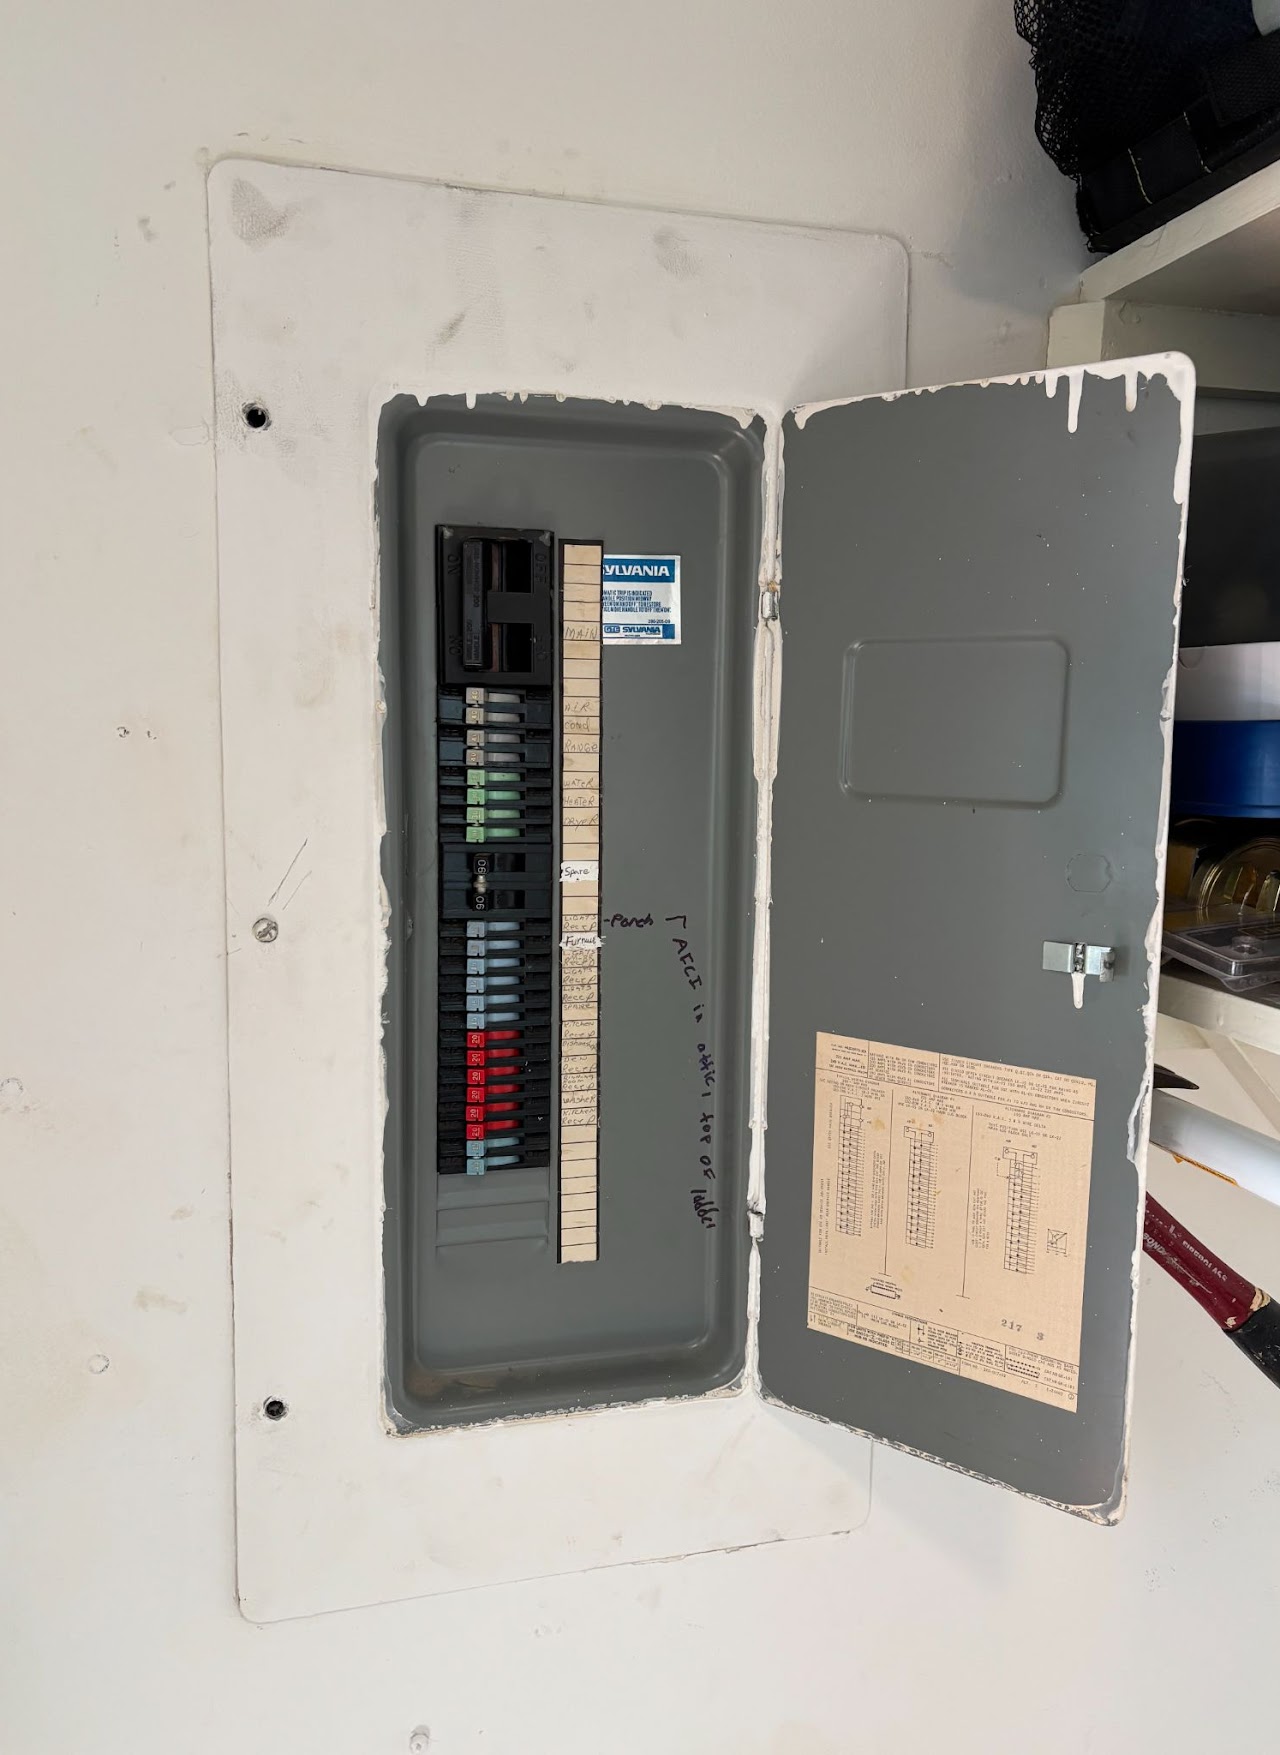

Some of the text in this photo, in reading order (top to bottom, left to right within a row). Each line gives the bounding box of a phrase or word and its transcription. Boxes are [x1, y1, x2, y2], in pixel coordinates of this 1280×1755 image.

[673, 938, 702, 990] AFCI
[693, 1004, 705, 1023] in
[699, 1112, 714, 1144] top
[1001, 1319, 1023, 1332] 217
